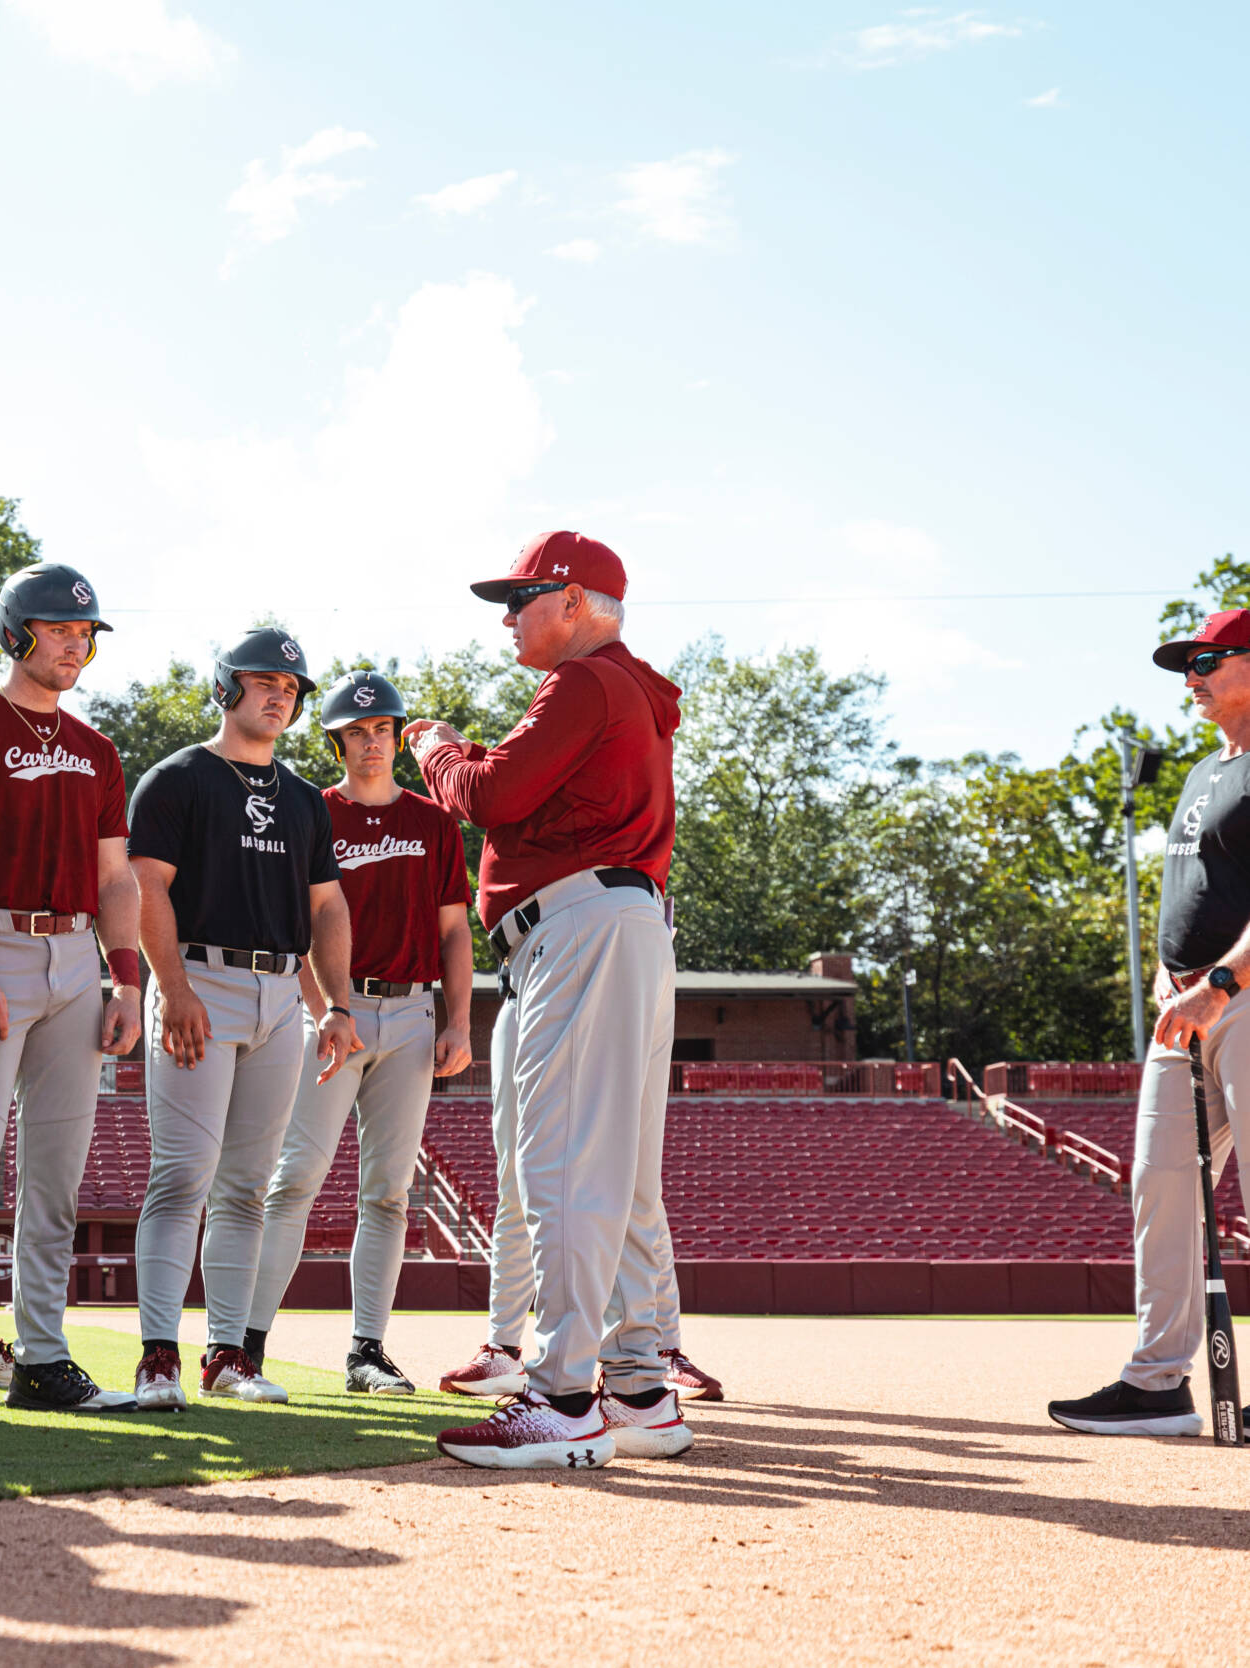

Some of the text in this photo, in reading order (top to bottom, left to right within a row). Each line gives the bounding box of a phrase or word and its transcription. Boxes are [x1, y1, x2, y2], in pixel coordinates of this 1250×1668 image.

[4, 744, 95, 776] Carolina
[333, 834, 426, 865] Carolina
[1226, 1400, 1237, 1442] FUNGO
